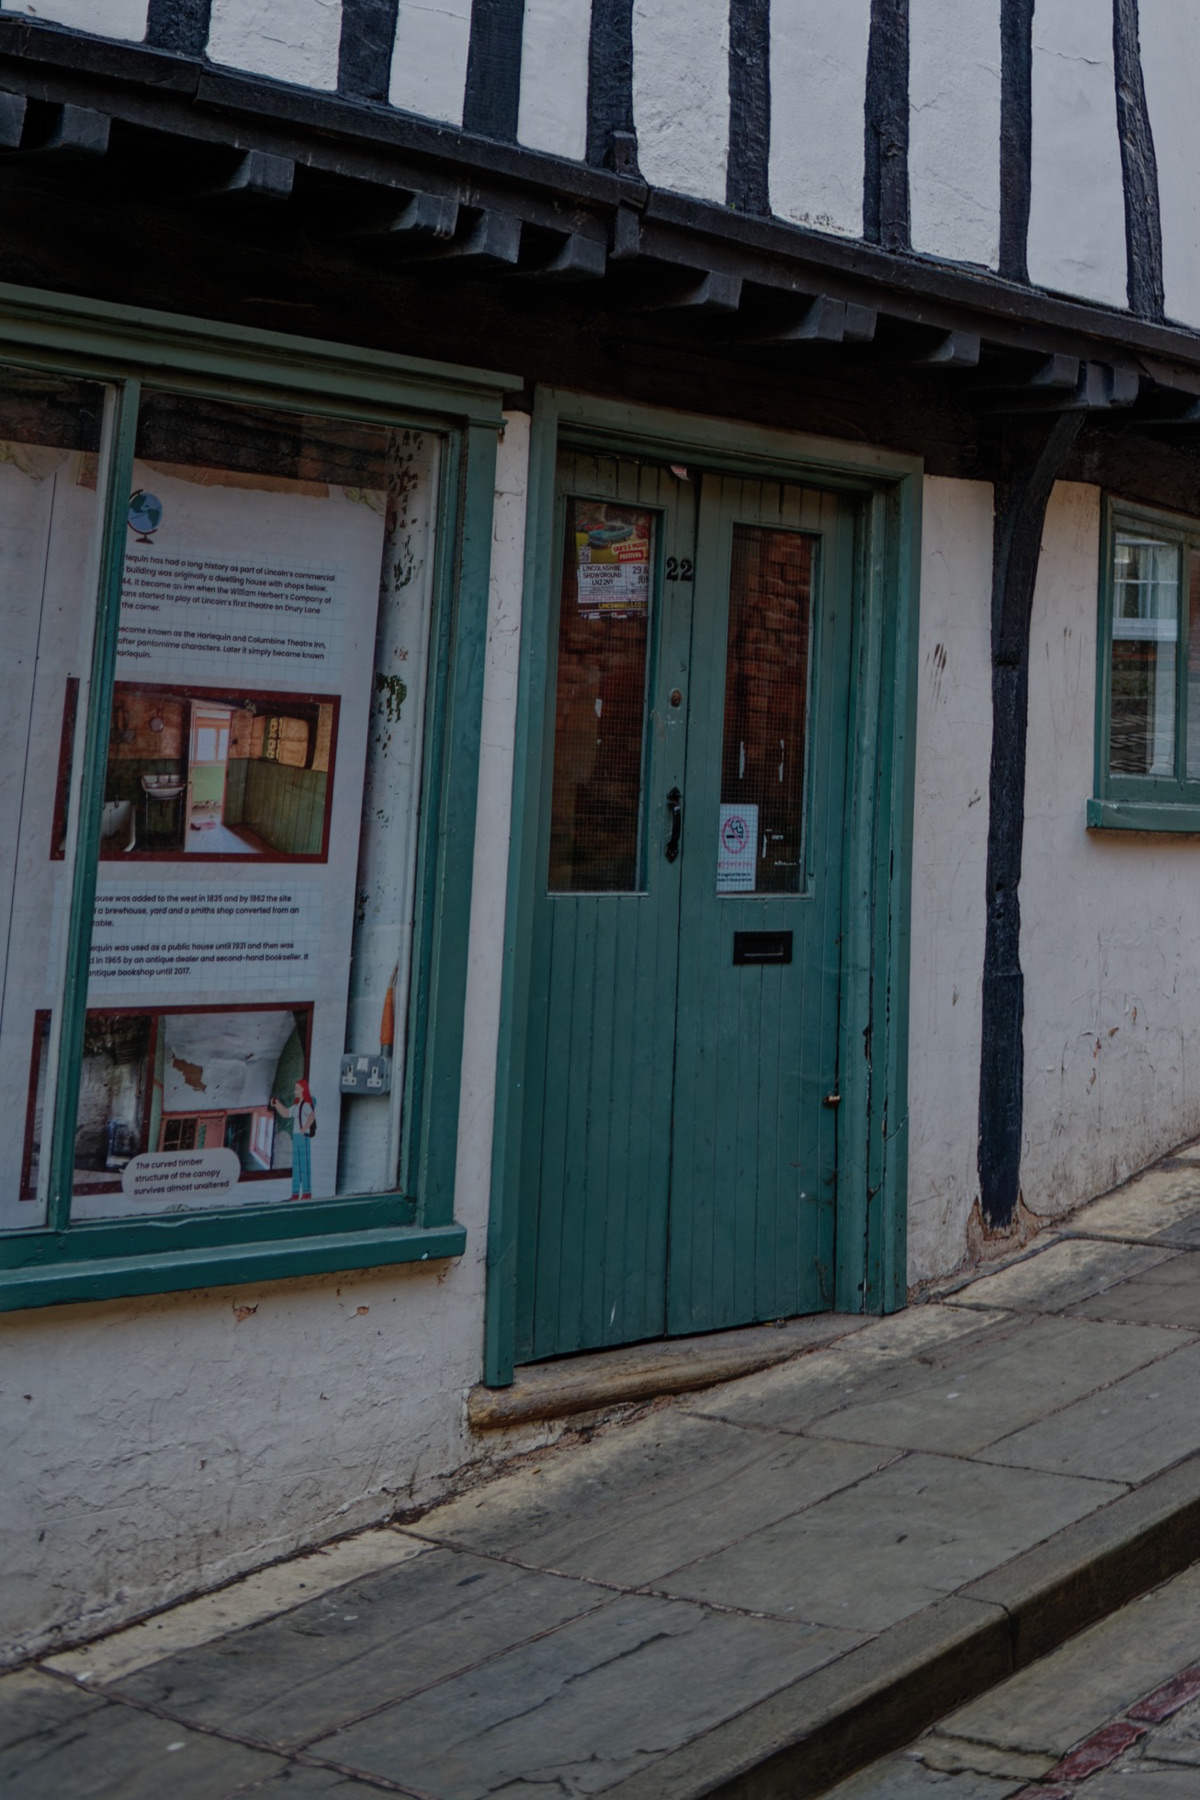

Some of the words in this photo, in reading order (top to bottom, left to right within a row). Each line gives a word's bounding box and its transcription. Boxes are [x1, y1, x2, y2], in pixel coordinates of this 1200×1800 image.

[150, 556, 163, 564] has
[165, 558, 179, 566] had
[187, 560, 203, 570] long
[204, 562, 228, 573] history
[264, 568, 294, 577] Lincoln's
[294, 572, 335, 582] commercial
[632, 566, 642, 574] 29
[666, 557, 692, 582] 22
[126, 566, 157, 577] building
[174, 571, 207, 582] originally
[215, 575, 244, 586] dwelling
[245, 578, 266, 586] house
[284, 582, 304, 591] shops
[305, 583, 328, 592] below.
[140, 579, 171, 589] became
[230, 588, 256, 596] William
[257, 590, 289, 600] Herbert's
[290, 593, 323, 605] Company
[138, 592, 165, 600] started
[175, 595, 191, 604] play
[201, 597, 231, 606] Lincoln's
[233, 599, 247, 607] first
[248, 601, 273, 610] theatre
[284, 604, 304, 614] Drury
[147, 627, 172, 636] known
[196, 632, 232, 642] Harlequin
[247, 636, 286, 645] Columbine
[287, 639, 313, 648] Theatre
[314, 641, 326, 649] Inn,
[137, 640, 180, 649] pantomime
[181, 642, 222, 652] characters.
[248, 647, 272, 657] simply
[272, 649, 301, 658] became
[302, 651, 324, 659] known
[239, 895, 248, 904] by
[149, 907, 167, 916] yard
[216, 907, 234, 916] shop
[167, 943, 191, 952] public
[215, 942, 231, 950] until
[122, 956, 132, 966] by
[145, 955, 174, 965] antique
[216, 954, 264, 962] second-hand
[117, 968, 155, 977] bookshop
[174, 967, 191, 975] 2017.
[151, 1160, 177, 1169] curved
[134, 1174, 169, 1182] structure
[192, 1170, 221, 1178] canopy
[134, 1186, 165, 1195] survives
[166, 1184, 192, 1192] almost
[194, 1180, 230, 1190] unaltered
